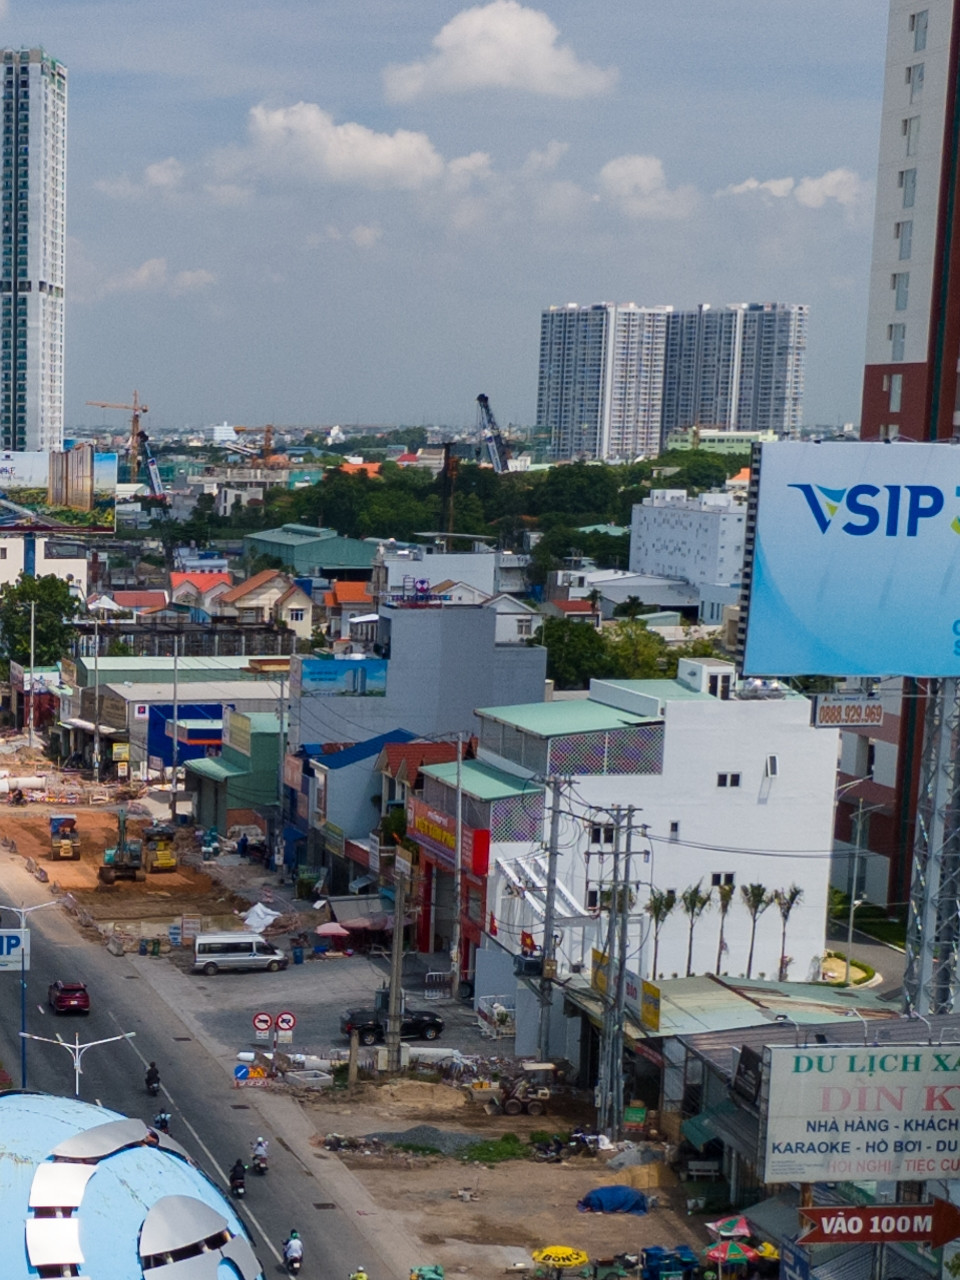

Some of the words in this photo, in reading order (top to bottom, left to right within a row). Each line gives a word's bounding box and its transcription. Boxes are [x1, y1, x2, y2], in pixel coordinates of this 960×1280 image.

[787, 484, 944, 537] VSIP
[792, 1054, 837, 1073] DU
[846, 1053, 923, 1077] LỊCH
[922, 1085, 960, 1111] K
[806, 1116, 840, 1132] NHÀ
[844, 1116, 889, 1132] HÀNG
[903, 1115, 959, 1132] KHÁCH
[772, 1141, 851, 1154] KARAOKE
[936, 1140, 958, 1153] DU
[821, 1211, 863, 1234] VÀO
